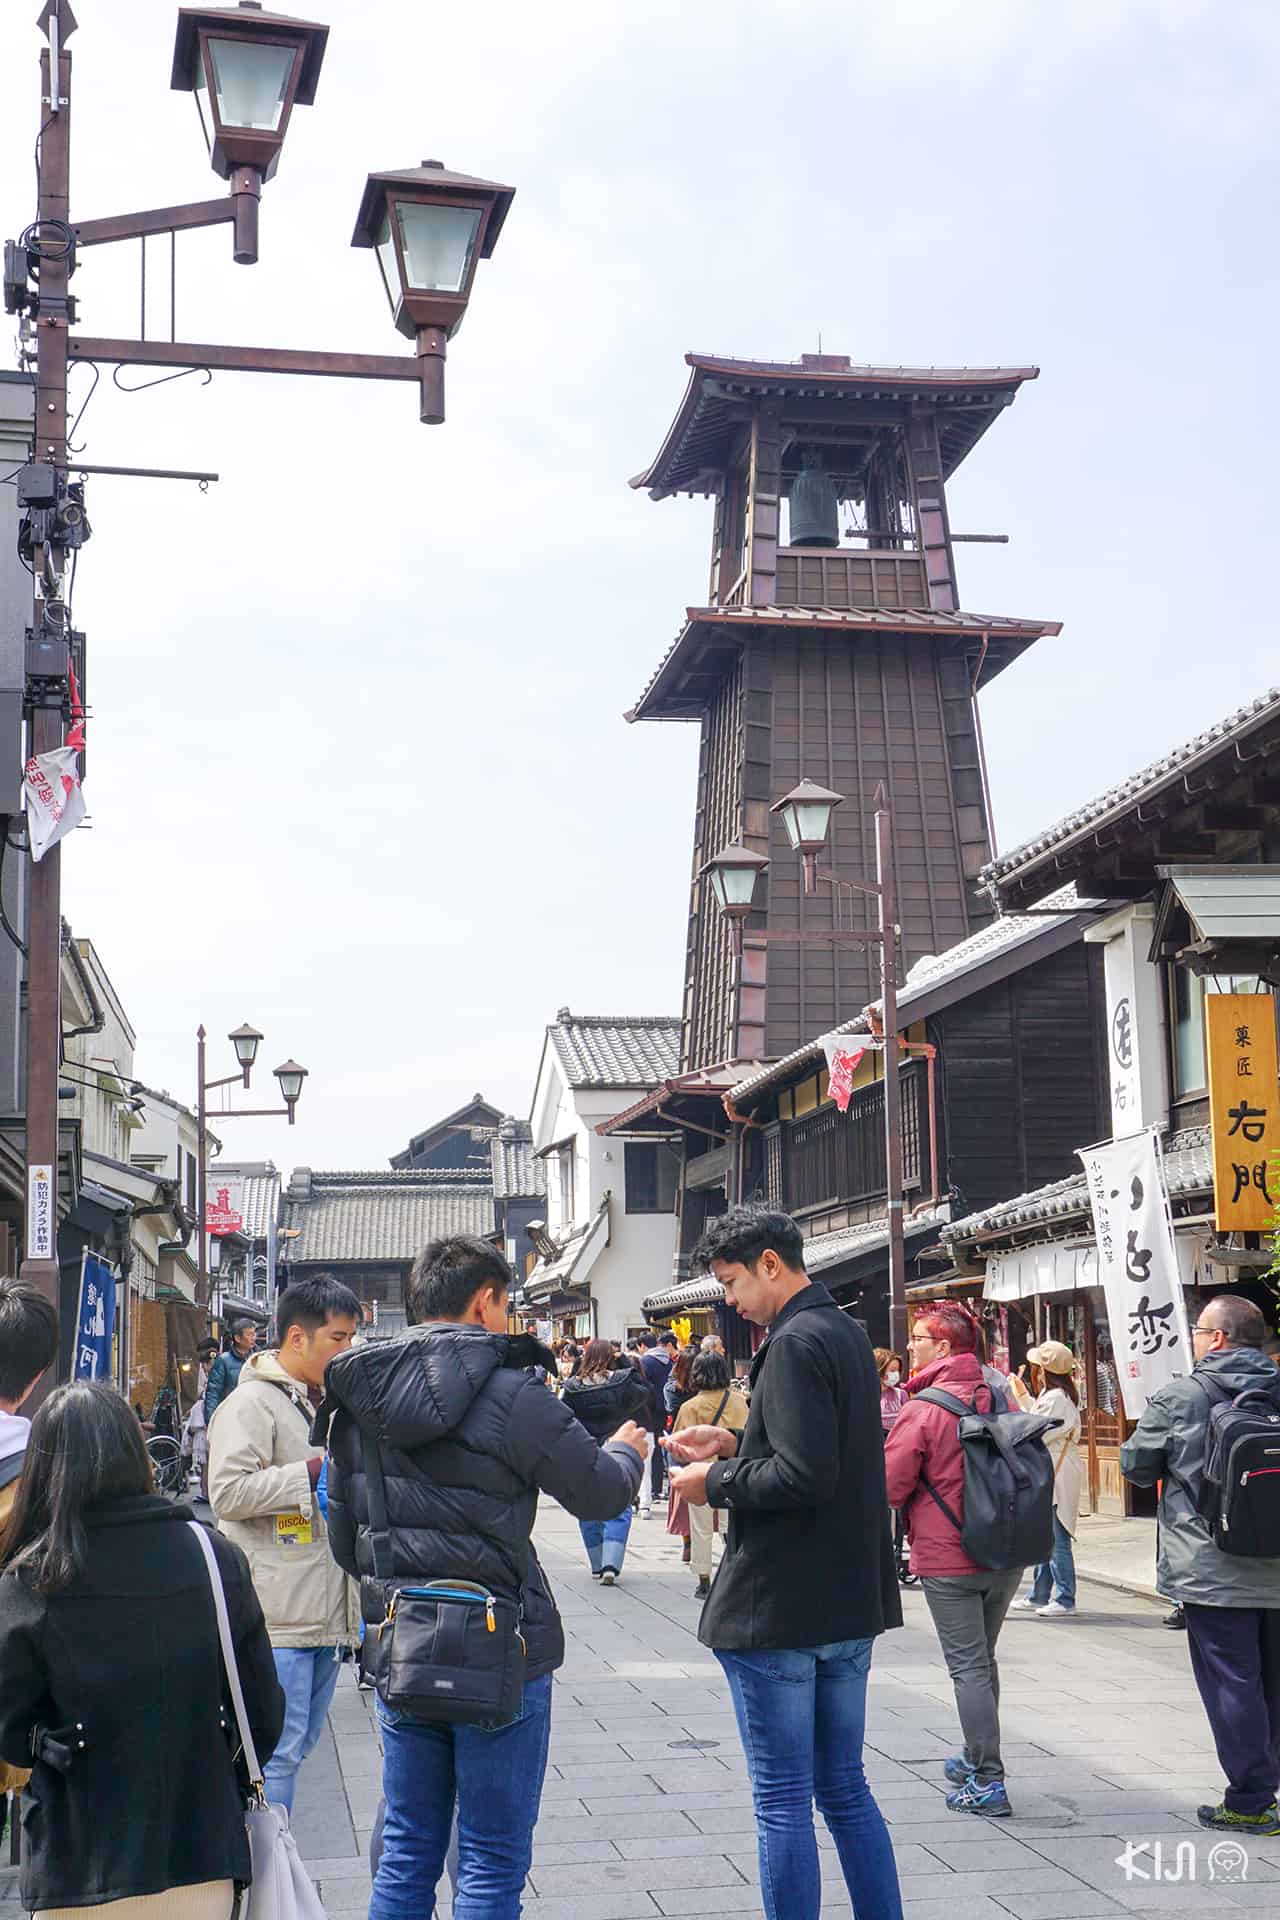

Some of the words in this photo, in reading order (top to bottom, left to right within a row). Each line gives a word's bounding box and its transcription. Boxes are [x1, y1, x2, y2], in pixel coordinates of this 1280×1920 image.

[1233, 1025, 1254, 1077] 菓匠
[1227, 1100, 1274, 1207] 右門
[36, 1181, 49, 1253] 防犯カメラ作動中
